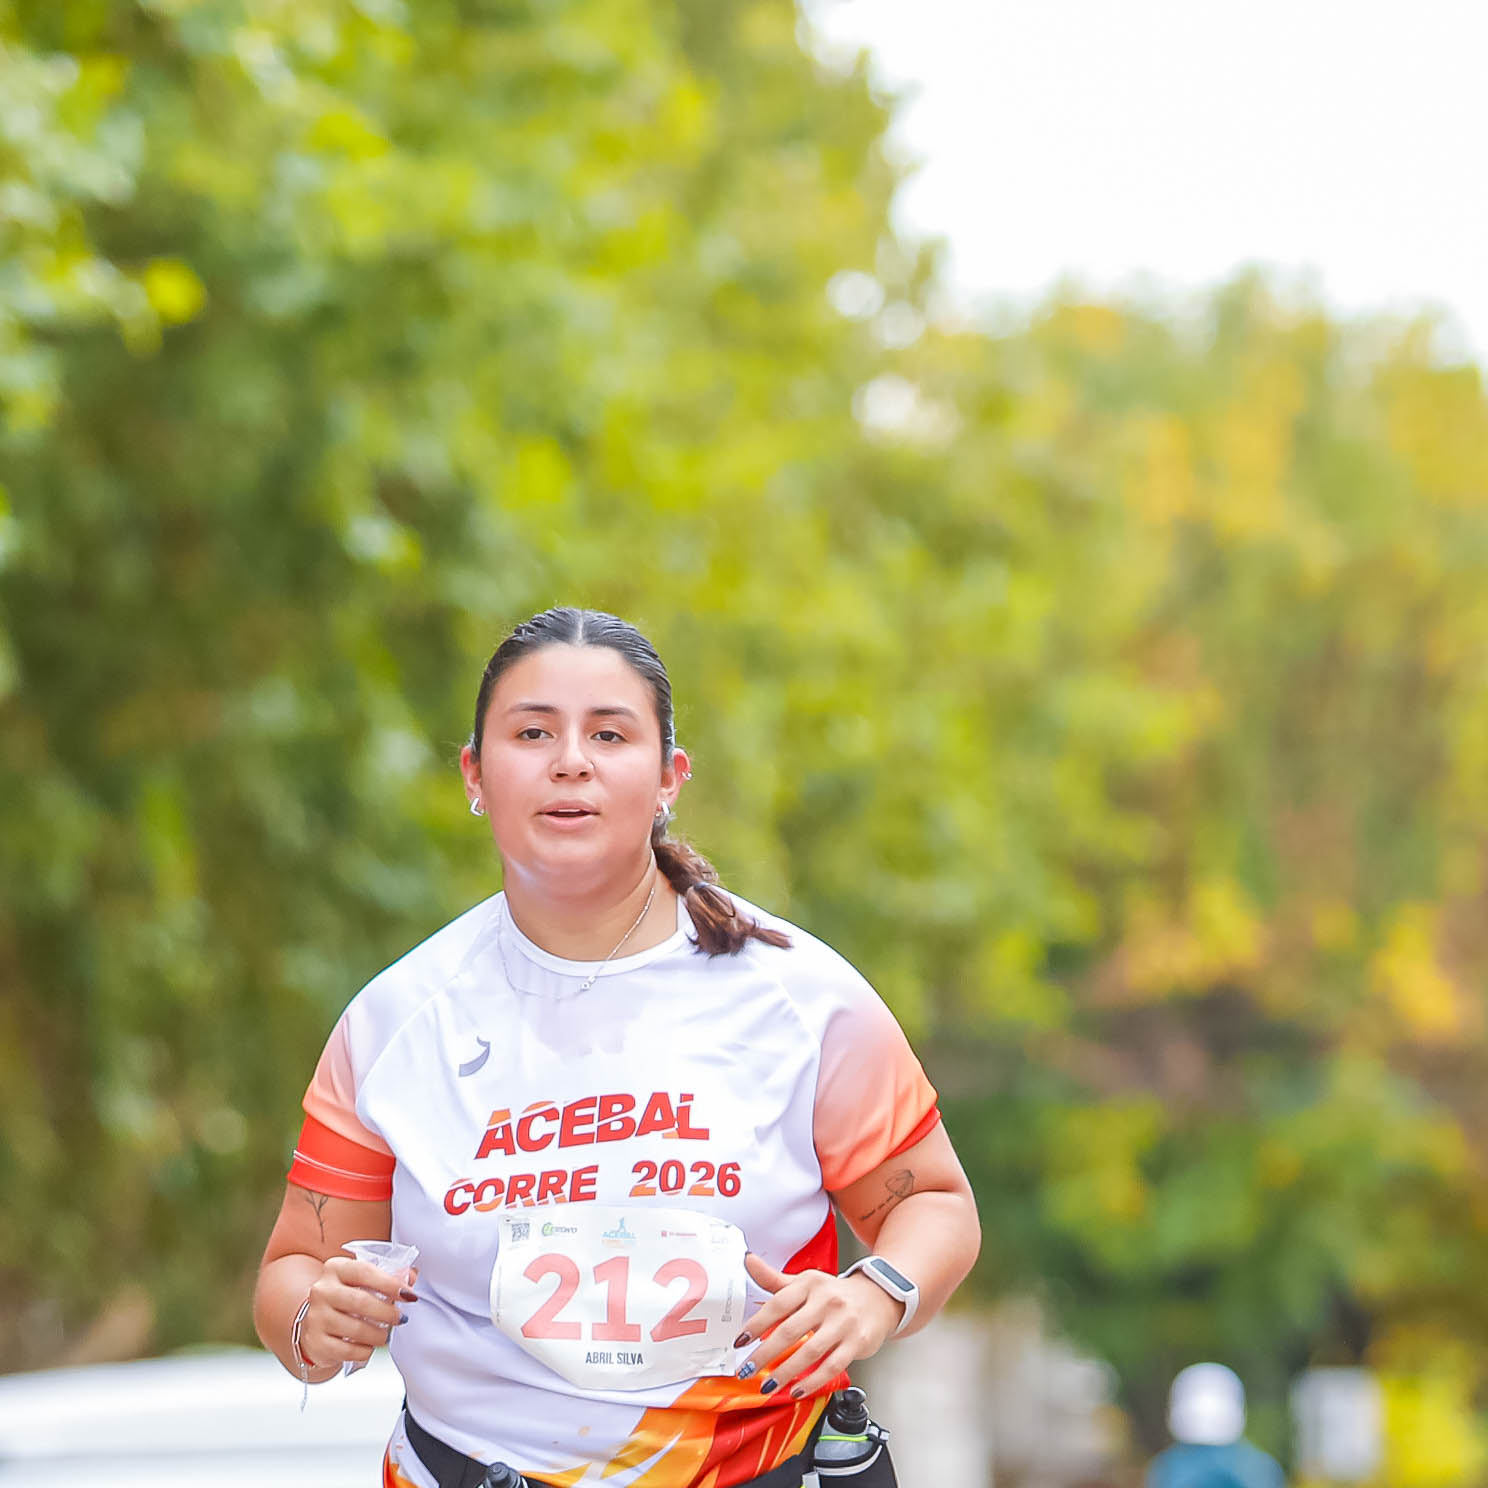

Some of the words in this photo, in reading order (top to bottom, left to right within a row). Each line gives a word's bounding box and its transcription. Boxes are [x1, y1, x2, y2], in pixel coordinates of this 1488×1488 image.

[473, 1091, 710, 1160] ACEBAL
[443, 1164, 599, 1216] CORRE
[629, 1159, 741, 1198] 2026
[520, 1253, 709, 1343] 212
[585, 1351, 614, 1365] ABRIL
[616, 1352, 644, 1365] SILVA
